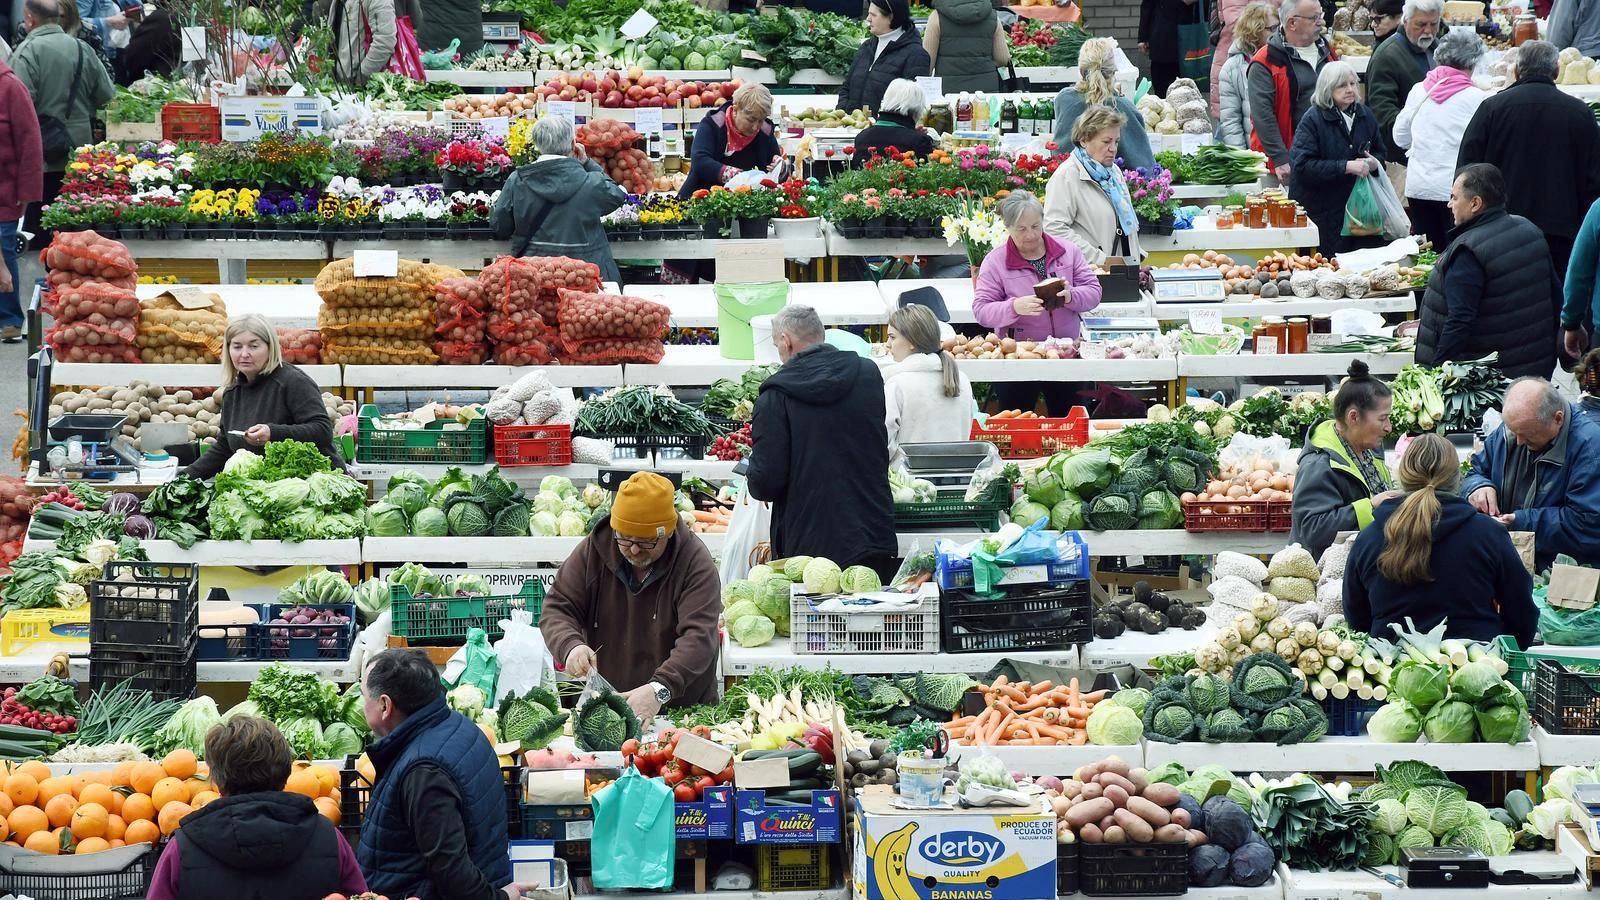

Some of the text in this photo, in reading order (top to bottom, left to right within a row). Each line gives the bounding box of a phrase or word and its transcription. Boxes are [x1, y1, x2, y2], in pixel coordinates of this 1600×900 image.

[255, 116, 288, 132] BONITA
[457, 575, 555, 585] OPRIVRNO
[675, 812, 707, 825] uinci
[761, 816, 815, 832] Quinci
[925, 833, 999, 864] derby
[932, 891, 993, 900] BANANAS
